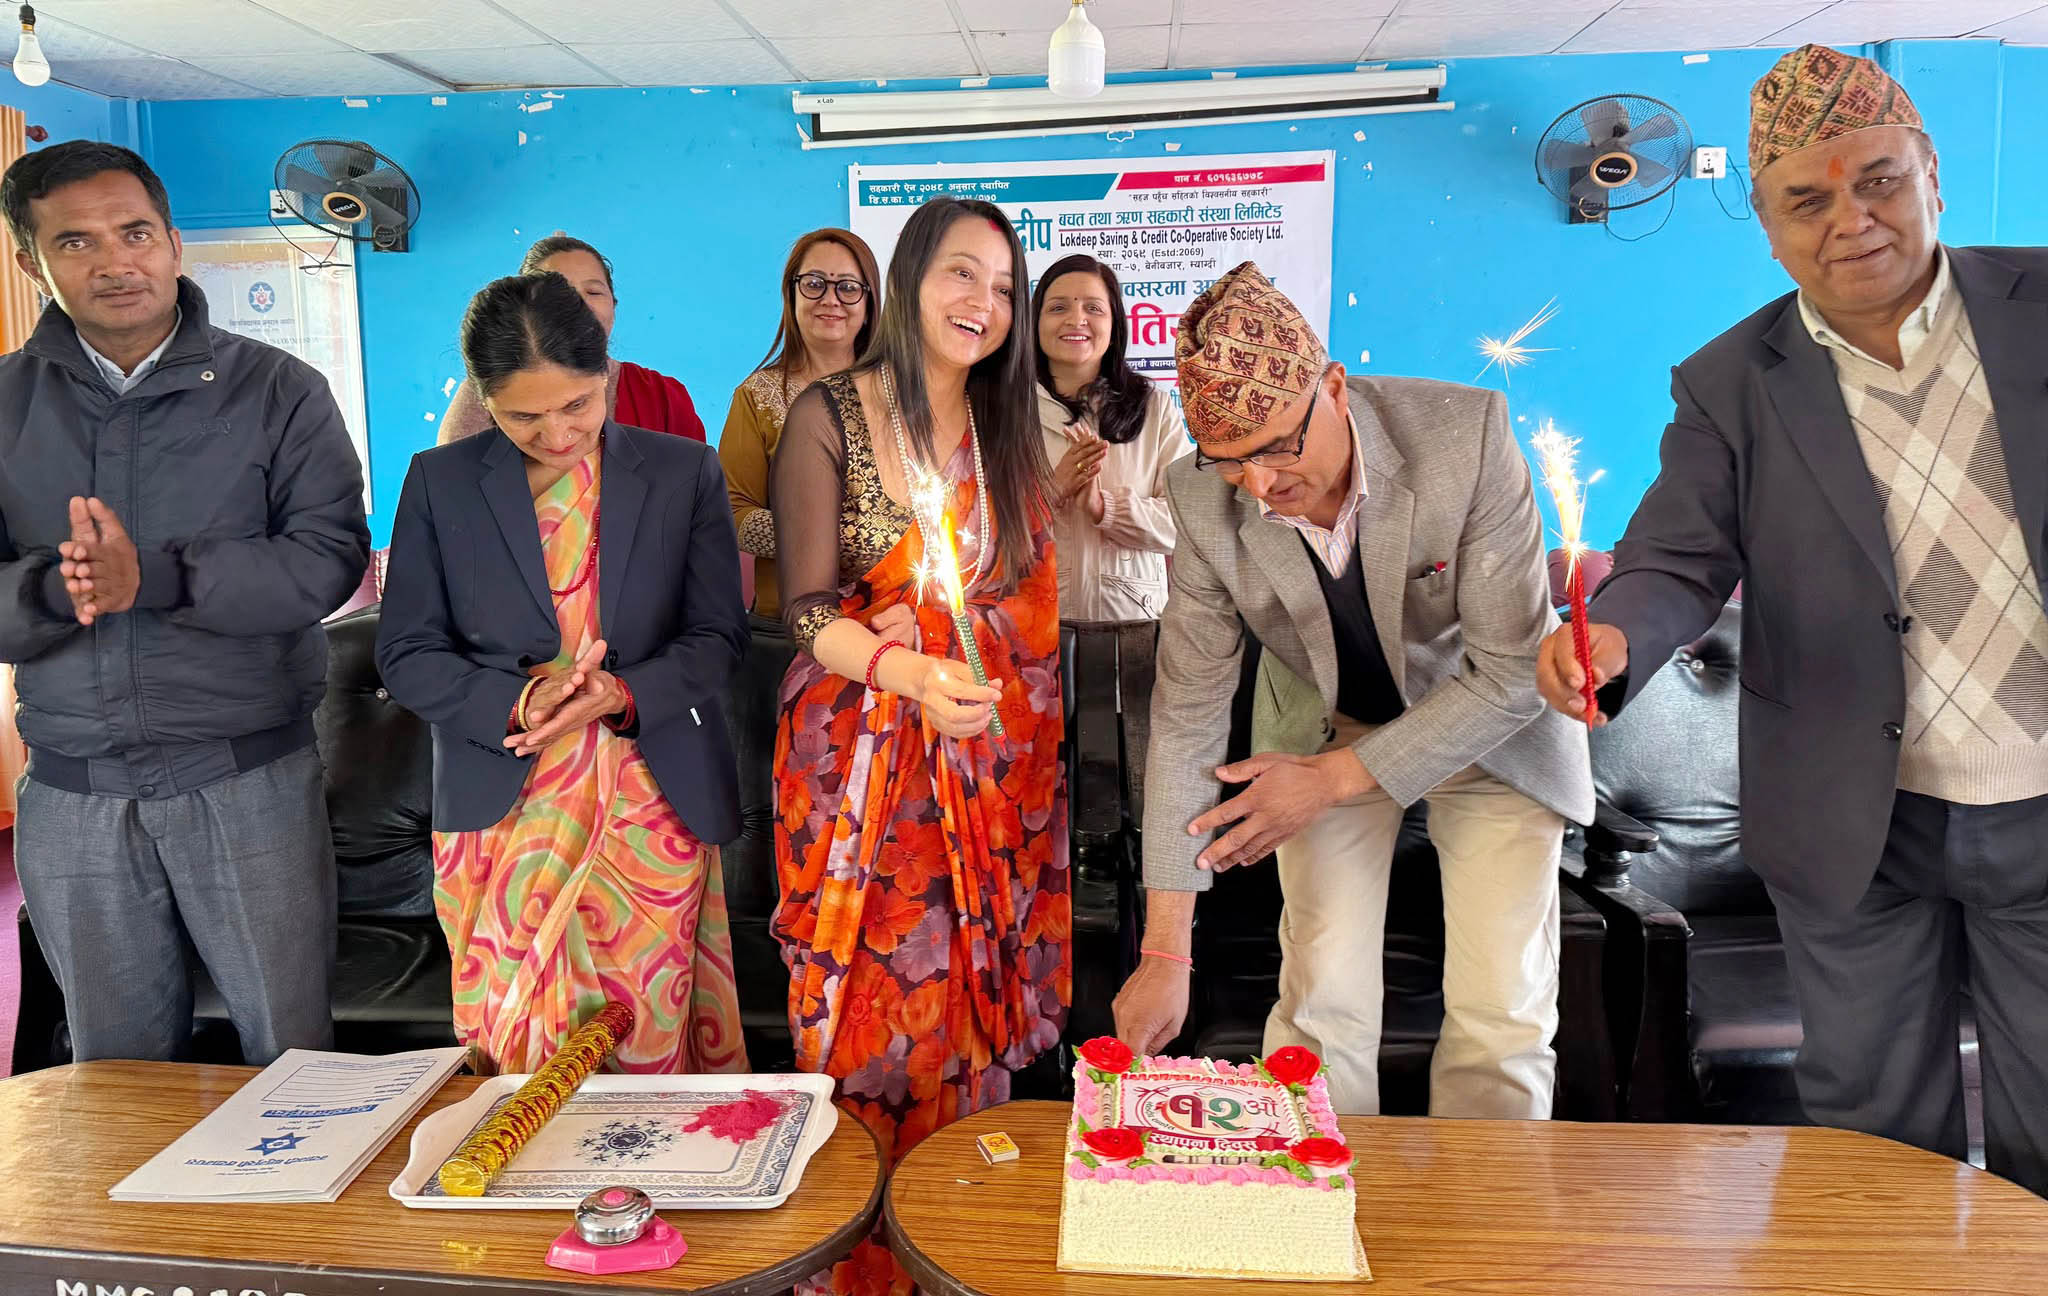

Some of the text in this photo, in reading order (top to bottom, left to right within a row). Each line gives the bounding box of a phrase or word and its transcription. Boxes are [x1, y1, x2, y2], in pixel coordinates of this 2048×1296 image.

[1599, 166, 1628, 175] WEGA
[1174, 174, 1190, 183] पान
[869, 180, 1010, 193] सहकारी ऐन २०४८ अनुसार स्थापित
[1058, 213, 1085, 227] बचत
[1089, 212, 1112, 226] तथा
[1116, 211, 1142, 225] ऋण
[1147, 205, 1194, 224] सहकारी
[1198, 205, 1231, 222] संस्था
[1235, 201, 1283, 220] लिमिटेड
[1060, 224, 1284, 250] Lokdeep Saving & Credit Co-Operative Society Ltd.
[1121, 249, 1146, 260] २०६९
[1151, 247, 1204, 260] (Estd:2069)
[1190, 257, 1217, 269] म्याग्दी
[1168, 1094, 1243, 1132] १२
[1150, 1133, 1259, 1151] स्थापना दिवस
